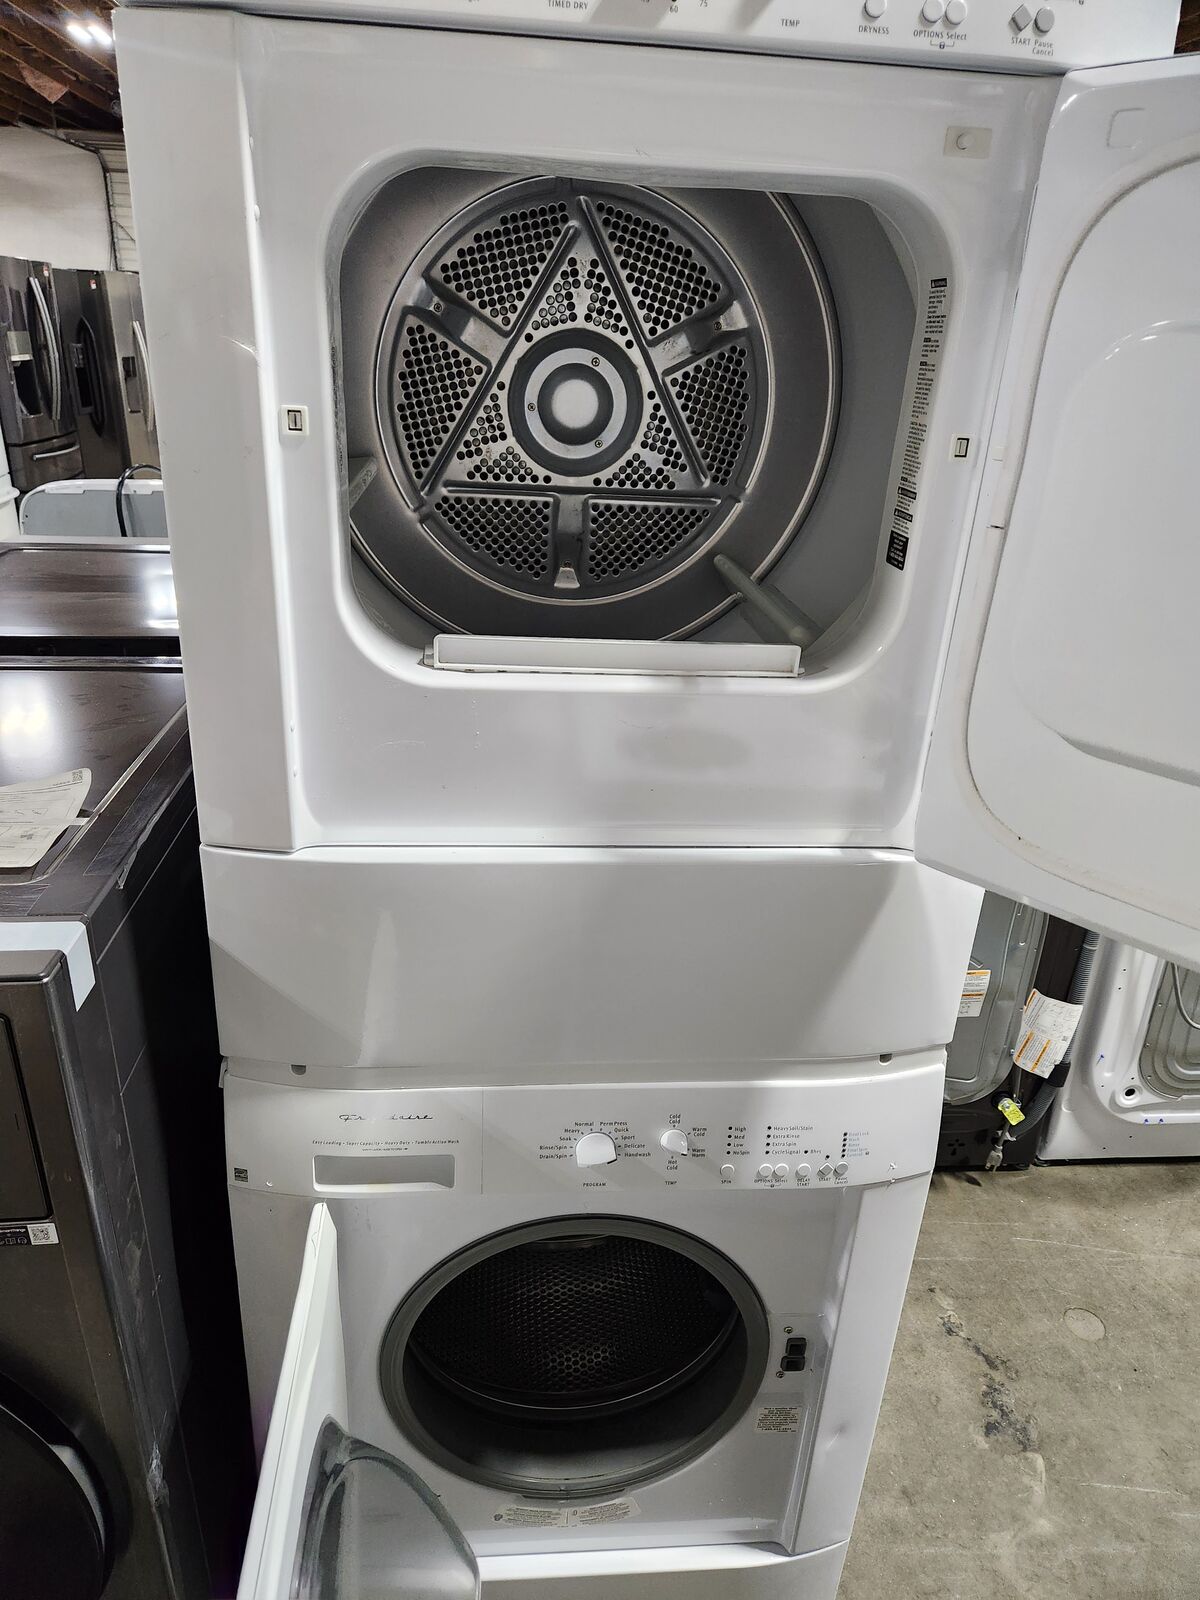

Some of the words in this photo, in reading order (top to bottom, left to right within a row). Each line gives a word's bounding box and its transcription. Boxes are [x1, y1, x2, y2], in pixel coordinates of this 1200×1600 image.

[548, 0, 571, 8] TIMED
[573, 2, 589, 10] DRY
[669, 5, 679, 13] 60
[780, 18, 800, 28] TEMP
[858, 25, 890, 35] DRYNESS
[913, 29, 944, 40] OPTIONS
[946, 31, 967, 41] Select
[1011, 36, 1031, 46] START
[1034, 38, 1054, 48] Pause
[1032, 47, 1054, 56] Cancel
